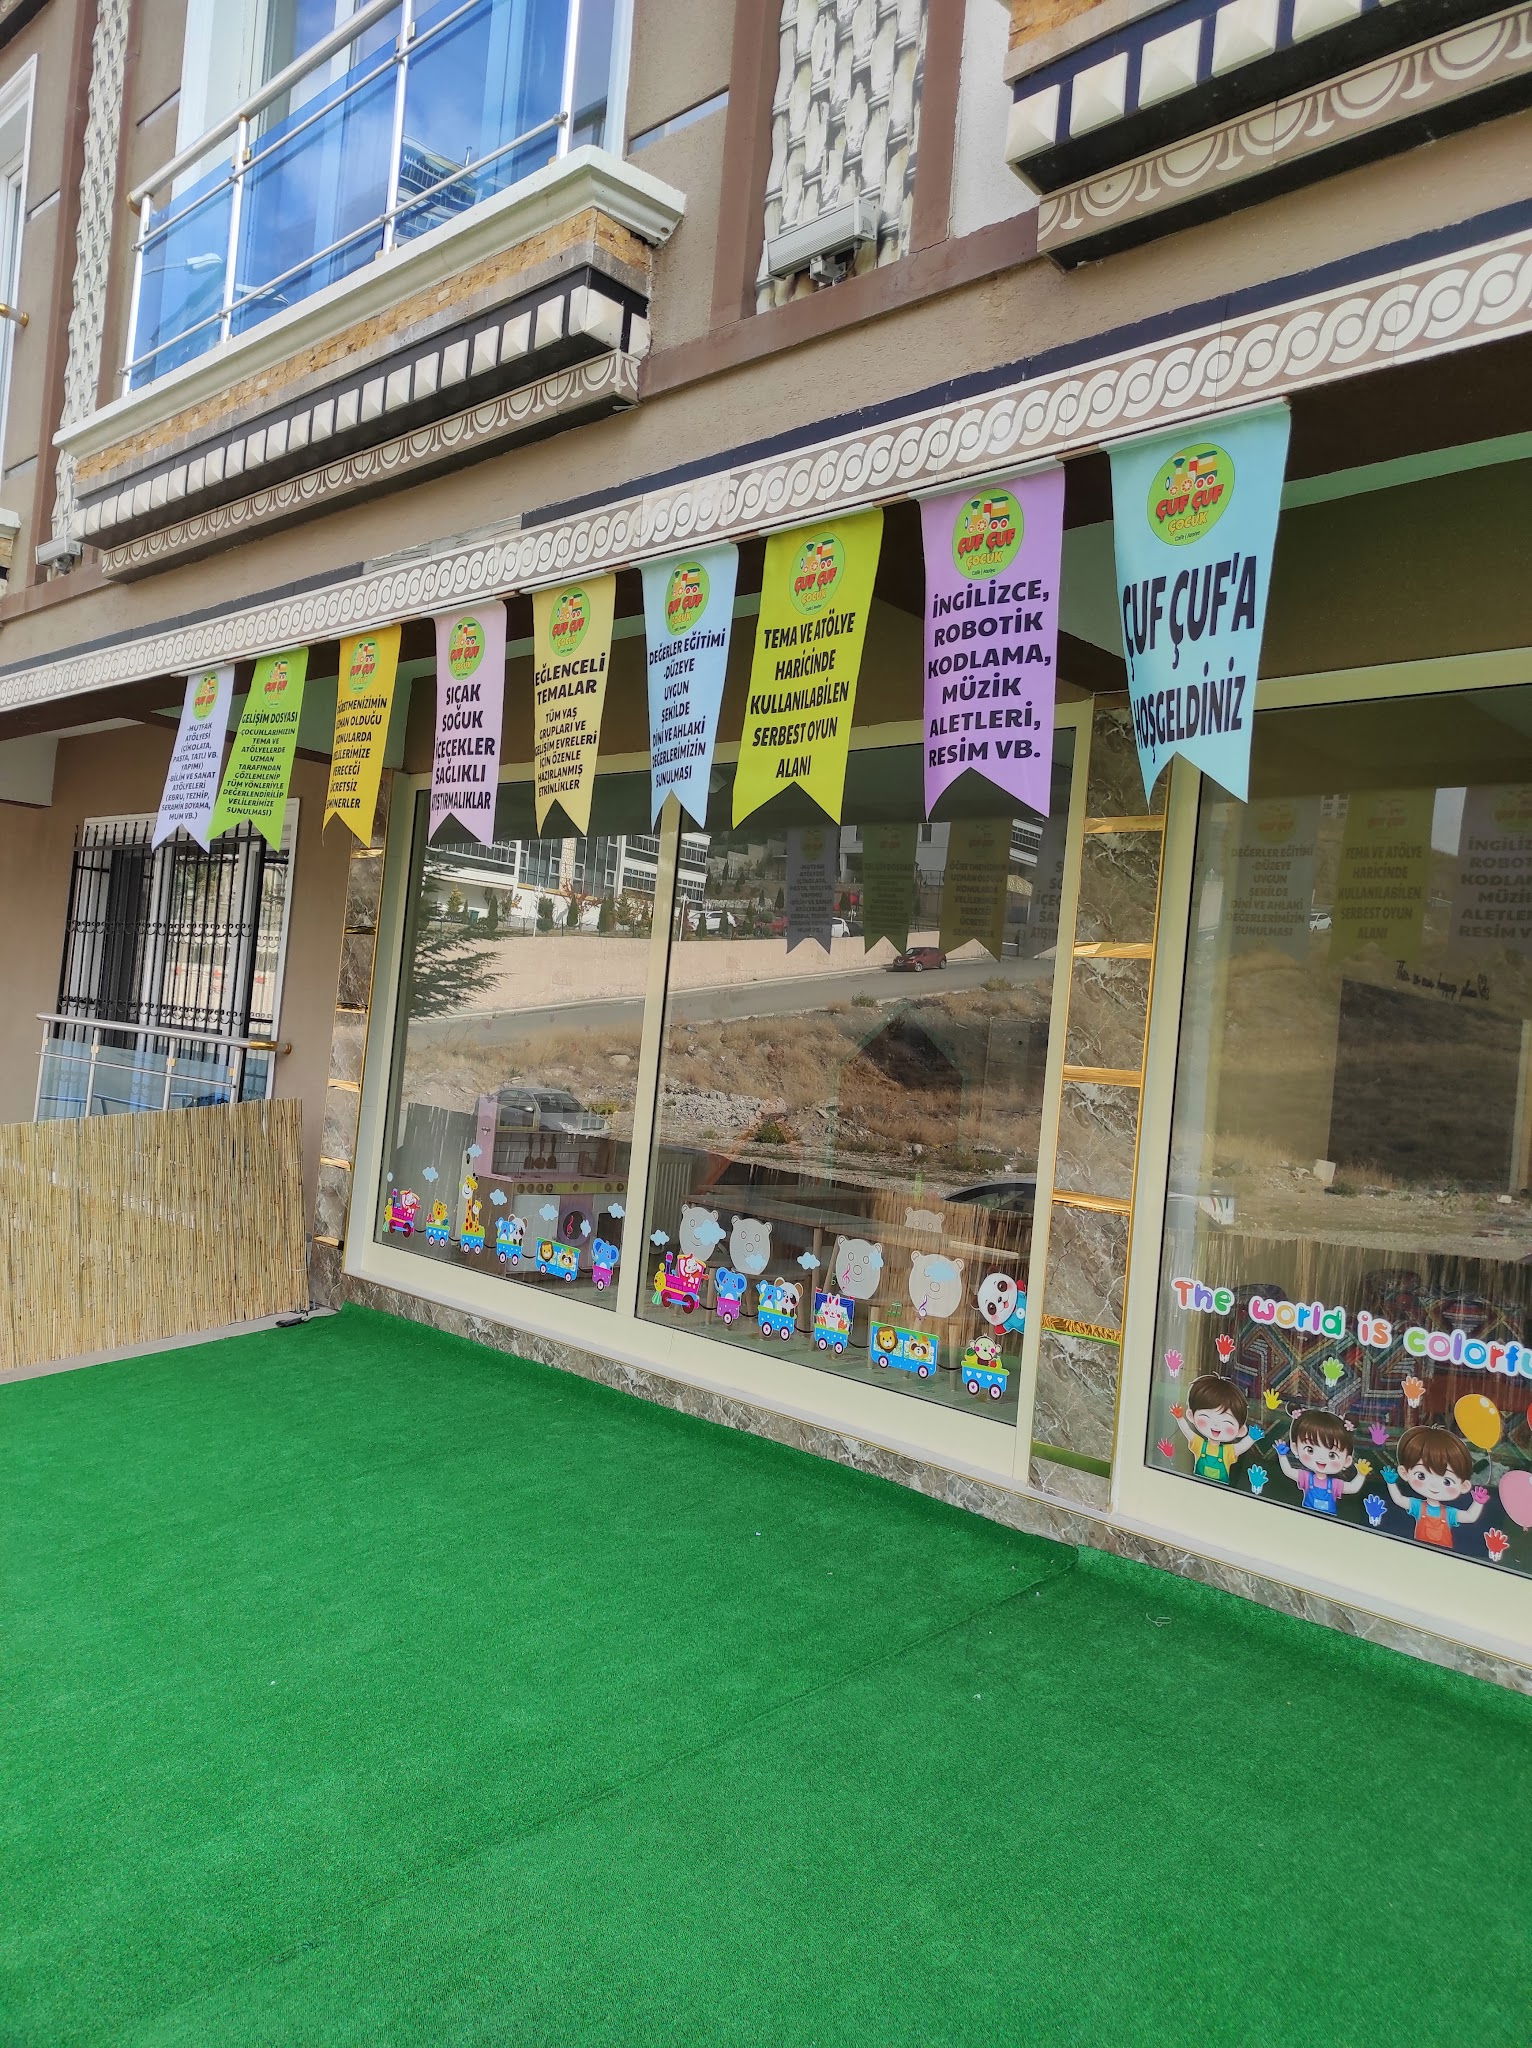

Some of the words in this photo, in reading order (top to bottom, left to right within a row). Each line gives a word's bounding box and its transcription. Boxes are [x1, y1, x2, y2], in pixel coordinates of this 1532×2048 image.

[1156, 494, 1190, 524] ÇUF
[1191, 484, 1224, 514] ÇUF
[1167, 510, 1208, 536] ÇOCUK
[958, 534, 984, 559] ÇUF
[986, 528, 1016, 553] ÇUF
[966, 551, 1003, 570] ÇOCUK
[932, 579, 1049, 618] İNGİLİZCE,
[764, 625, 797, 649] TEMA
[800, 622, 812, 643] VE
[814, 609, 855, 641] ATÖLYE
[934, 608, 1043, 647] ROBOTİK
[1122, 576, 1167, 681] ÇUF
[1169, 552, 1257, 670] ÇUF'A
[649, 641, 682, 665] DEĞERLER
[684, 628, 725, 652] EĞİTİMİ
[535, 653, 606, 686] EĞLENCELİ
[775, 647, 836, 680] HARİCİNDE
[928, 644, 1051, 679] KODLAMA,
[446, 684, 481, 705] SICAK
[537, 680, 597, 705] TEMALAR
[664, 680, 689, 700] UYGUN
[750, 677, 850, 715] KULLANILABİLEN
[942, 672, 1022, 704] MÜZİK
[242, 710, 269, 726] GELİŞİM
[271, 712, 298, 723] DOSYASI
[350, 710, 382, 726] OLDUĞU
[442, 704, 483, 732] SOĞUK
[546, 708, 560, 723] TÜM
[563, 707, 577, 720] YAŞ
[930, 701, 1040, 738] ALETLERİ,
[1133, 656, 1246, 764] HOŞGELDİNİZ
[185, 730, 211, 742] ATÖLYESİ
[540, 724, 573, 740] GRUPLARI
[575, 720, 586, 731] VE
[556, 731, 597, 749] EVRELERİ
[664, 728, 671, 742] VE
[673, 716, 705, 740] AHLAKİ
[752, 723, 806, 747] SERBEST
[808, 717, 838, 741] OYUN
[241, 745, 286, 753] ATÖLYELERDE
[552, 750, 581, 764] ÖZENLE
[652, 738, 706, 768] DEĞERLERİMİZİN
[929, 737, 988, 768] RESİM
[995, 740, 1041, 759] VB.
[235, 771, 280, 780] GÖZLEMLENİP
[436, 758, 486, 784] SAĞLIKLI
[538, 764, 583, 783] HAZIRLANMIŞ
[656, 766, 692, 788] SUNULMASI
[776, 755, 811, 778] ALANI
[223, 788, 283, 798] DEĞERLENDİRİLİP
[227, 779, 242, 787] TÜM
[244, 781, 284, 789] YÖNLERİYLE
[539, 779, 580, 797] ETKİNLİKLER
[226, 807, 272, 816] SUNULMASI)
[229, 797, 274, 807] VELİLERİMİZE
[1173, 1279, 1232, 1313] The
[1251, 1298, 1343, 1335] world
[1359, 1313, 1389, 1345] is
